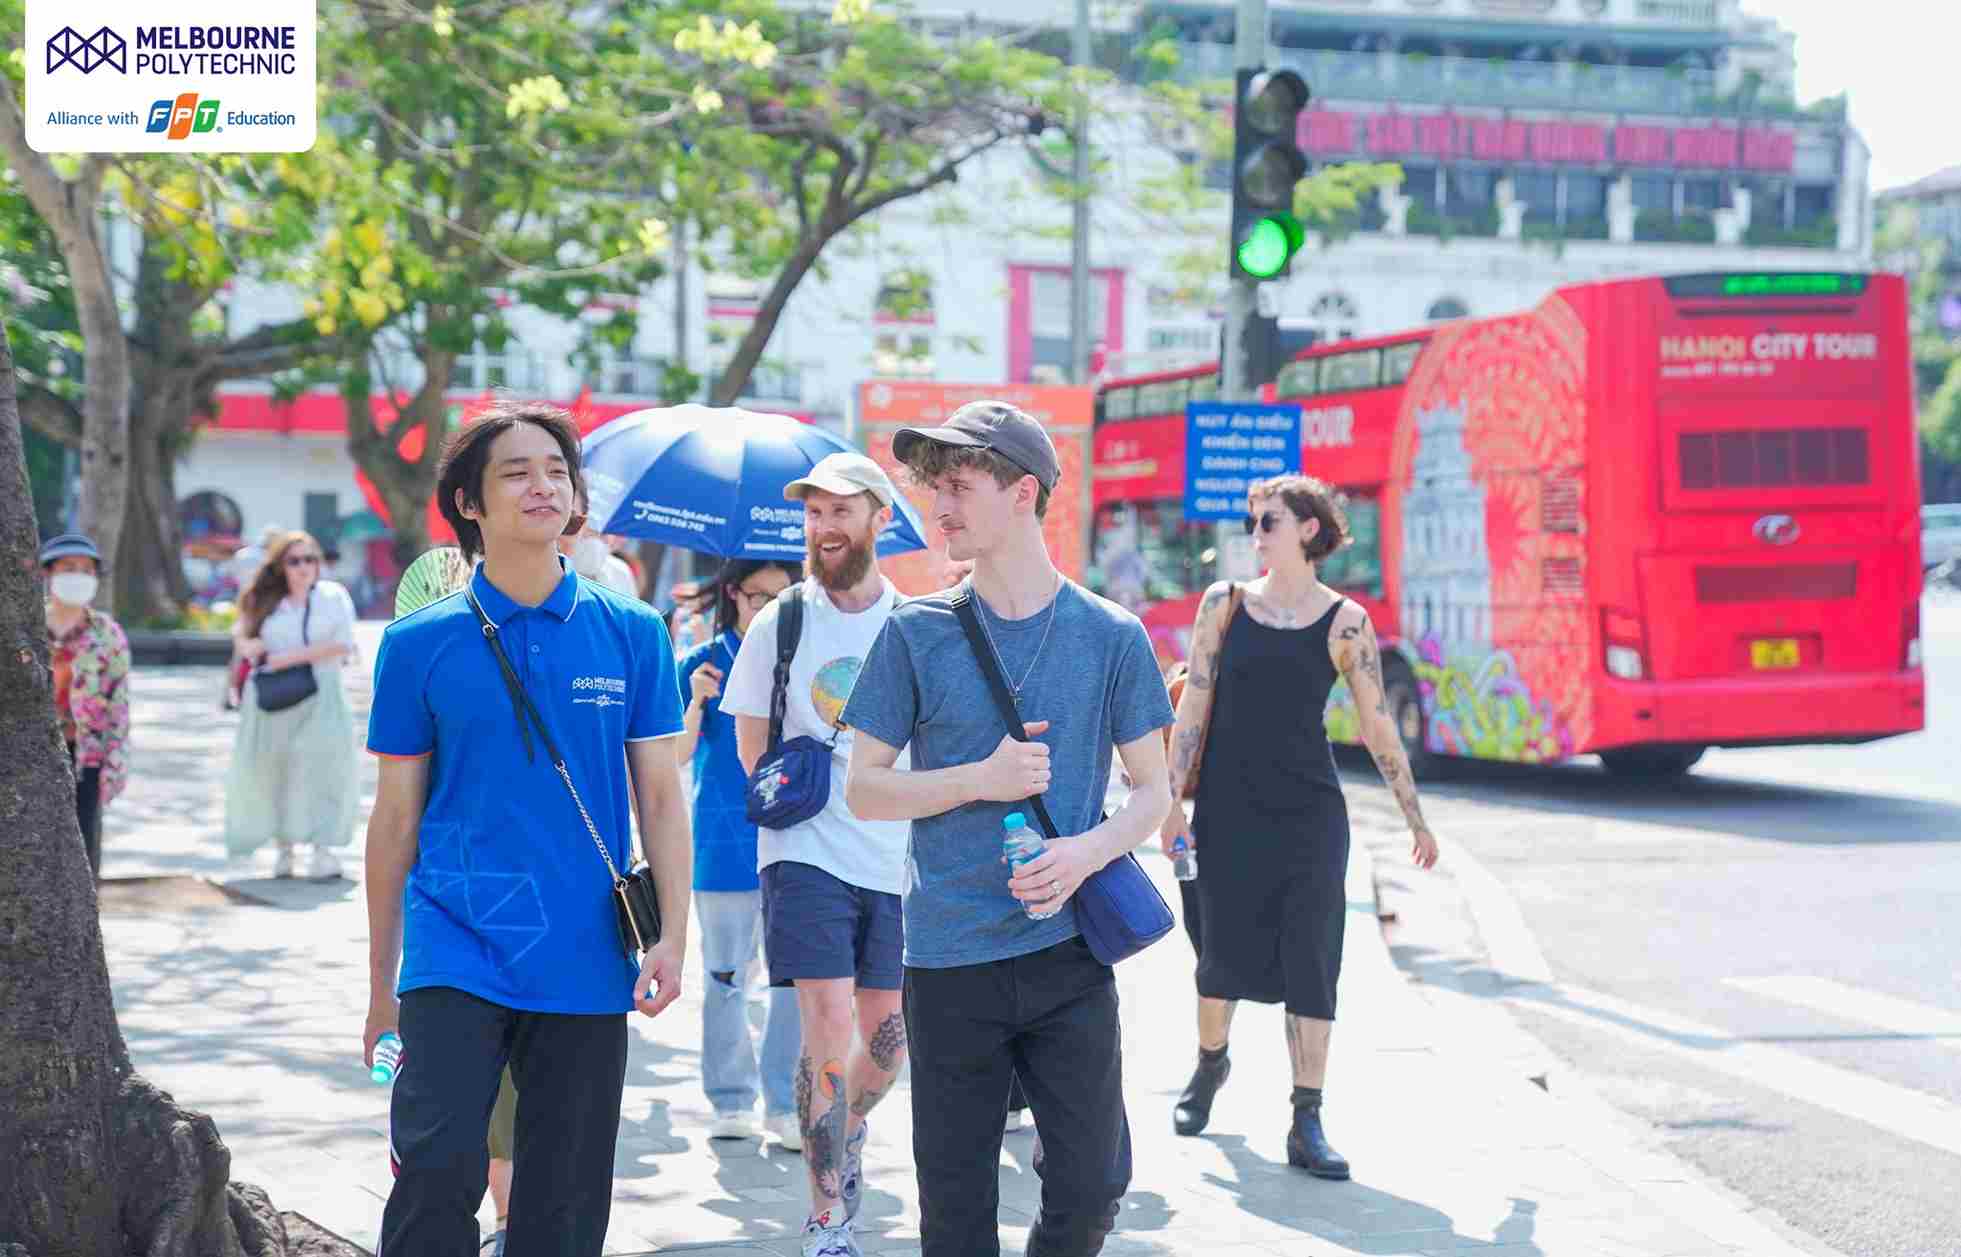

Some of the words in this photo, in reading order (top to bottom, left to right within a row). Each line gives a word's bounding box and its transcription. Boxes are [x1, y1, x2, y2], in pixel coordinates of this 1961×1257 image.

[1660, 335, 1746, 360] HANOI
[1752, 333, 1808, 360] CITY
[1813, 333, 1878, 360] TOUR
